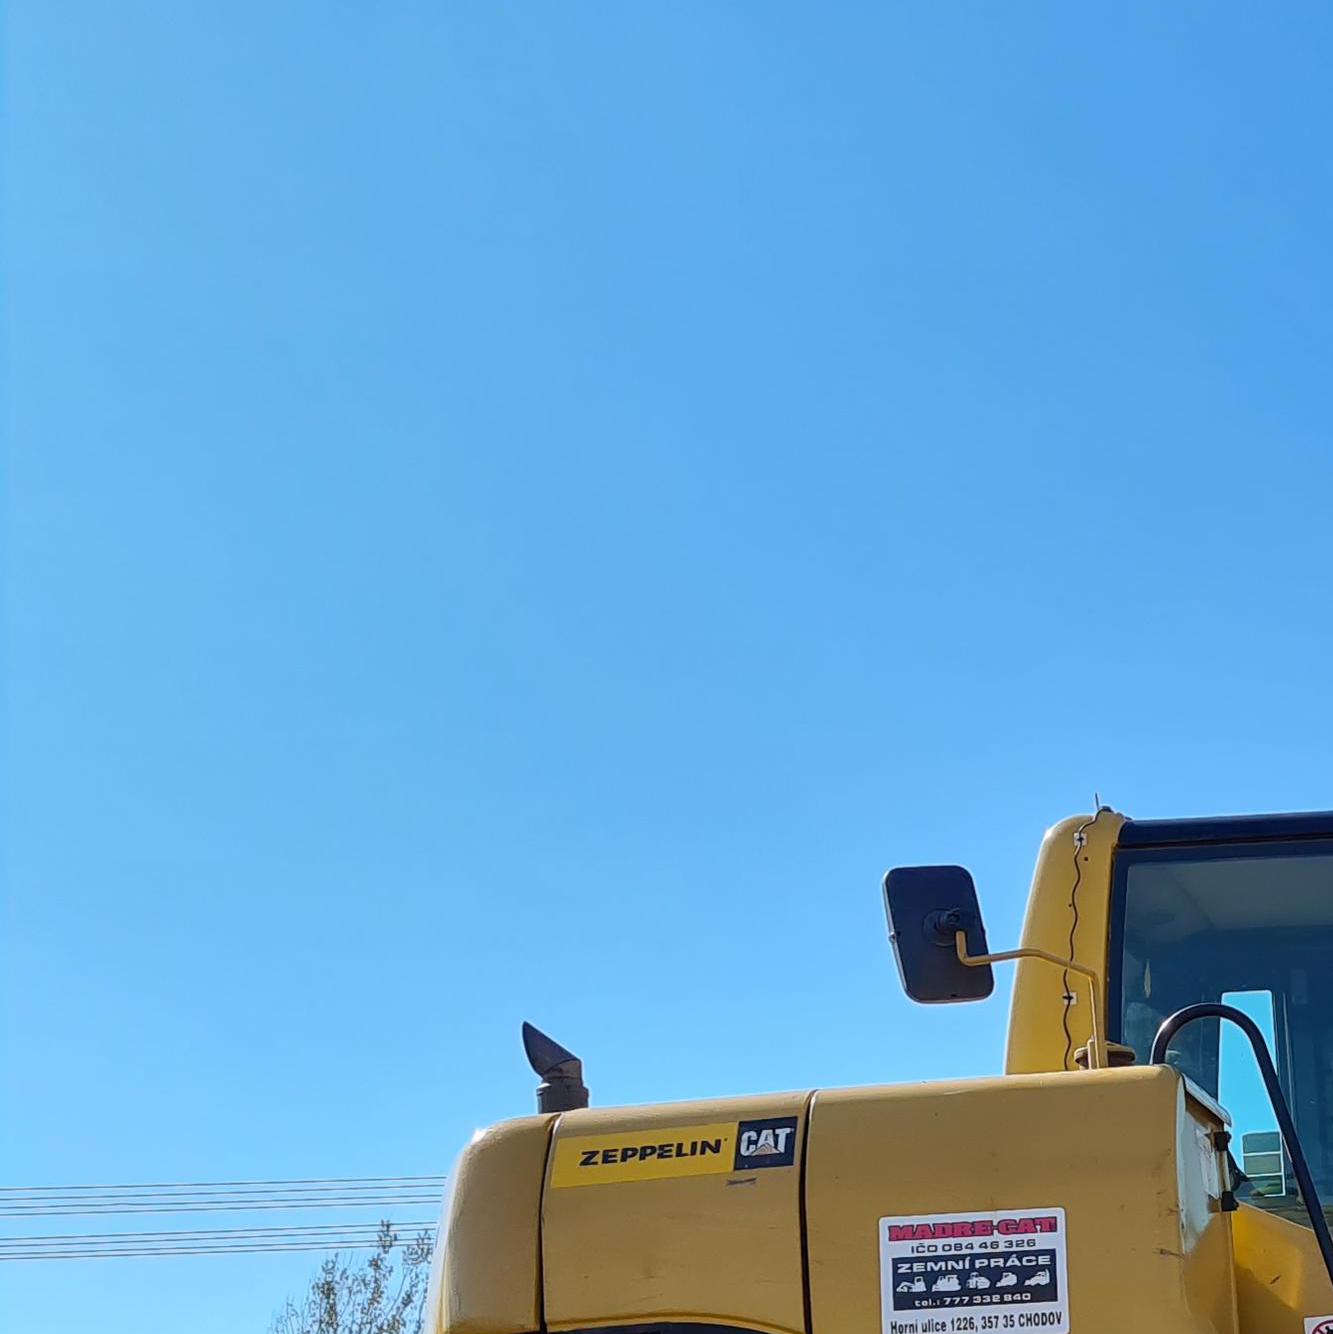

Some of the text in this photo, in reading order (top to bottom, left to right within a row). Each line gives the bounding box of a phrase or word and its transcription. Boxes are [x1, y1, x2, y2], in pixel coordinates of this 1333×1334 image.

[579, 1127, 794, 1167] ZEPPELIN CAT
[888, 1216, 1057, 1241] MADRE-CAT
[911, 1239, 1036, 1254] IČO 084 46 326
[897, 1254, 1051, 1273] ZEMNÍ PRÁCE
[943, 1297, 970, 1305] 777
[1003, 1293, 1031, 1302] 840
[921, 1318, 947, 1333] ulice
[950, 1316, 978, 1332] 1226,
[981, 1315, 999, 1329] 357
[1002, 1314, 1015, 1328] 35
[1018, 1311, 1062, 1327] CHODOV
